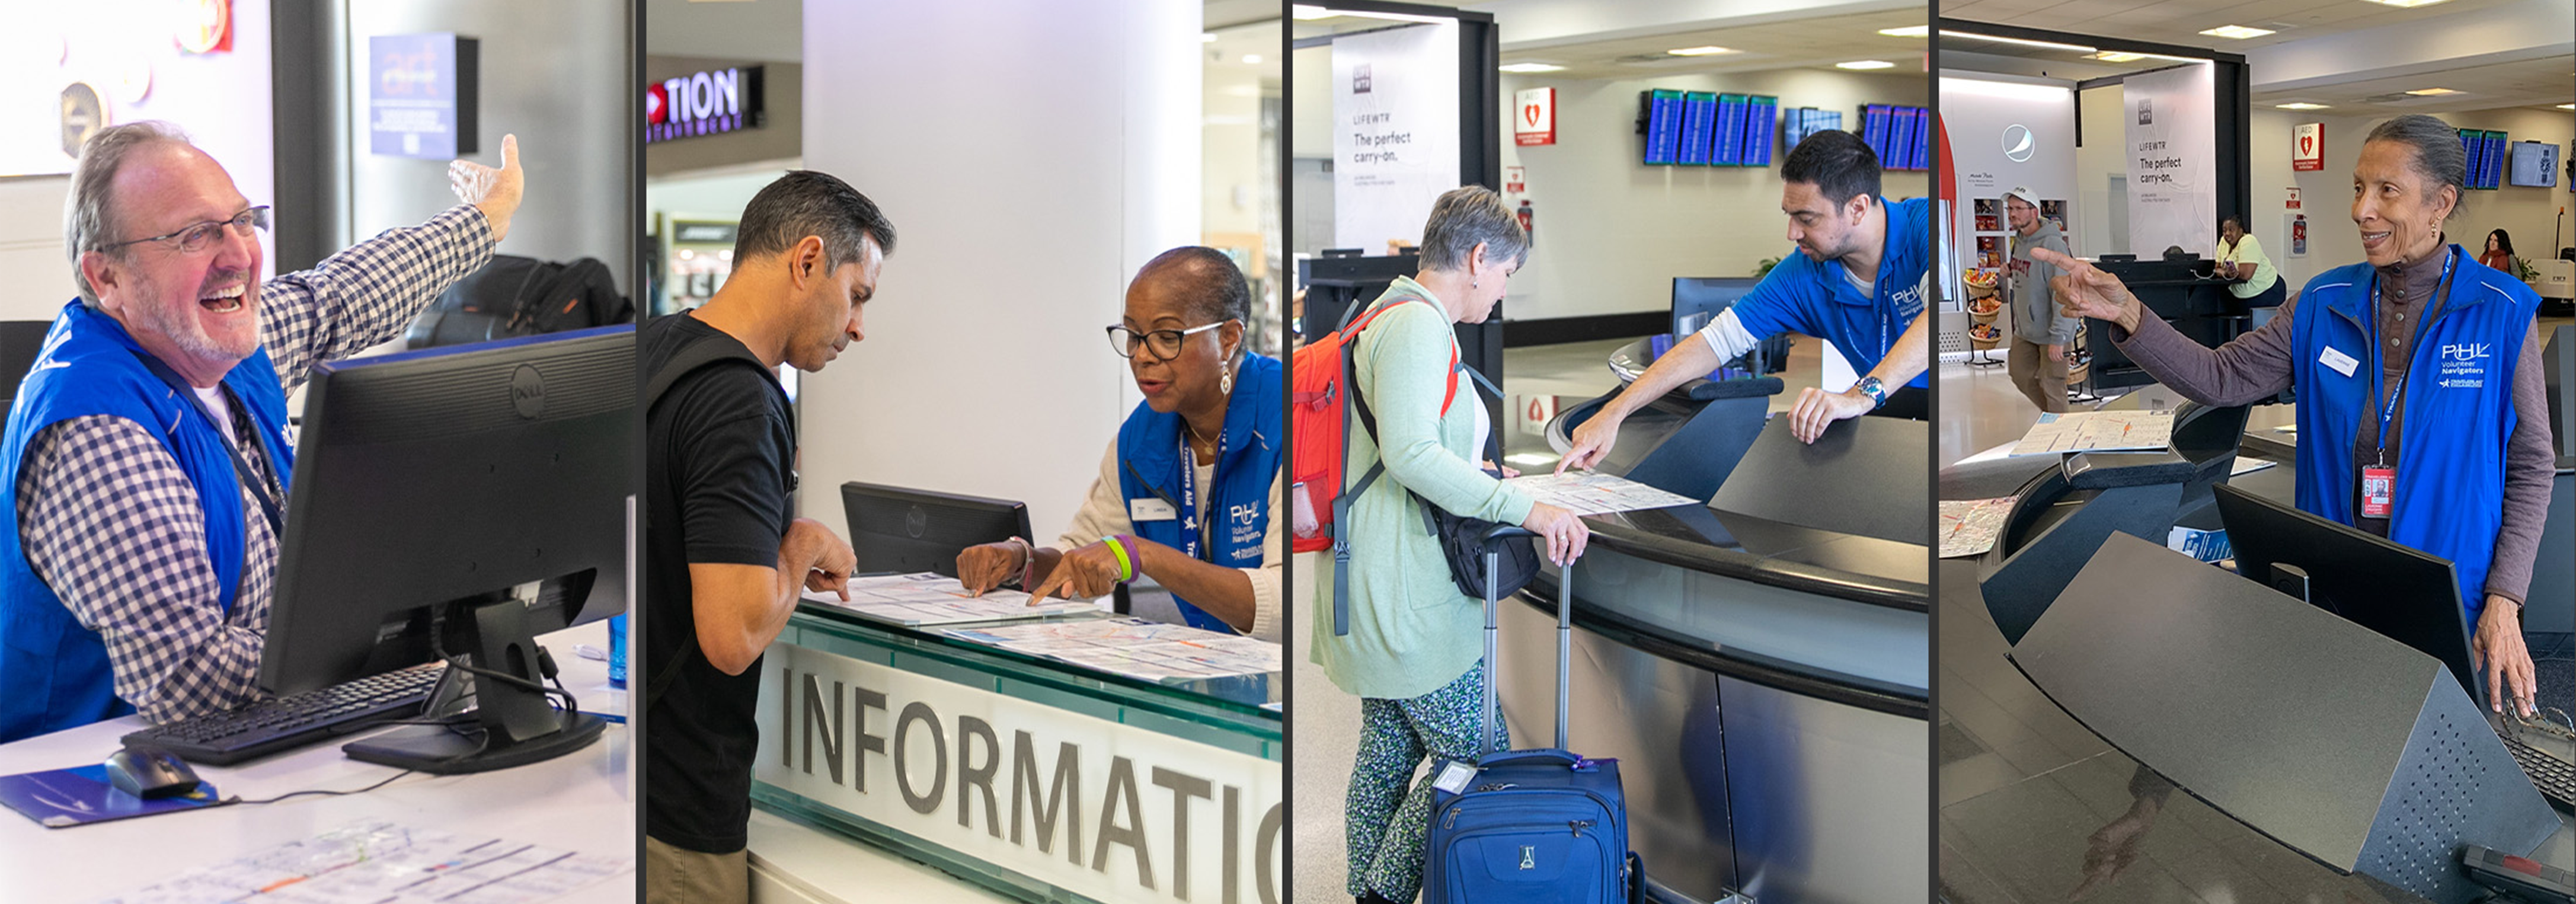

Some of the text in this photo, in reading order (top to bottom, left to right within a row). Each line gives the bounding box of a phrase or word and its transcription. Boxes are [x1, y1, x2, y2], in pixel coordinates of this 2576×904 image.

[1354, 131, 1411, 148] The perfect
[1354, 151, 1398, 165] carry-on.
[2140, 156, 2182, 170] The perfect
[2140, 174, 2172, 185] carry-on.
[2442, 343, 2490, 360] PHL
[2442, 367, 2484, 375] Navigators
[1185, 490, 1193, 506] Aid
